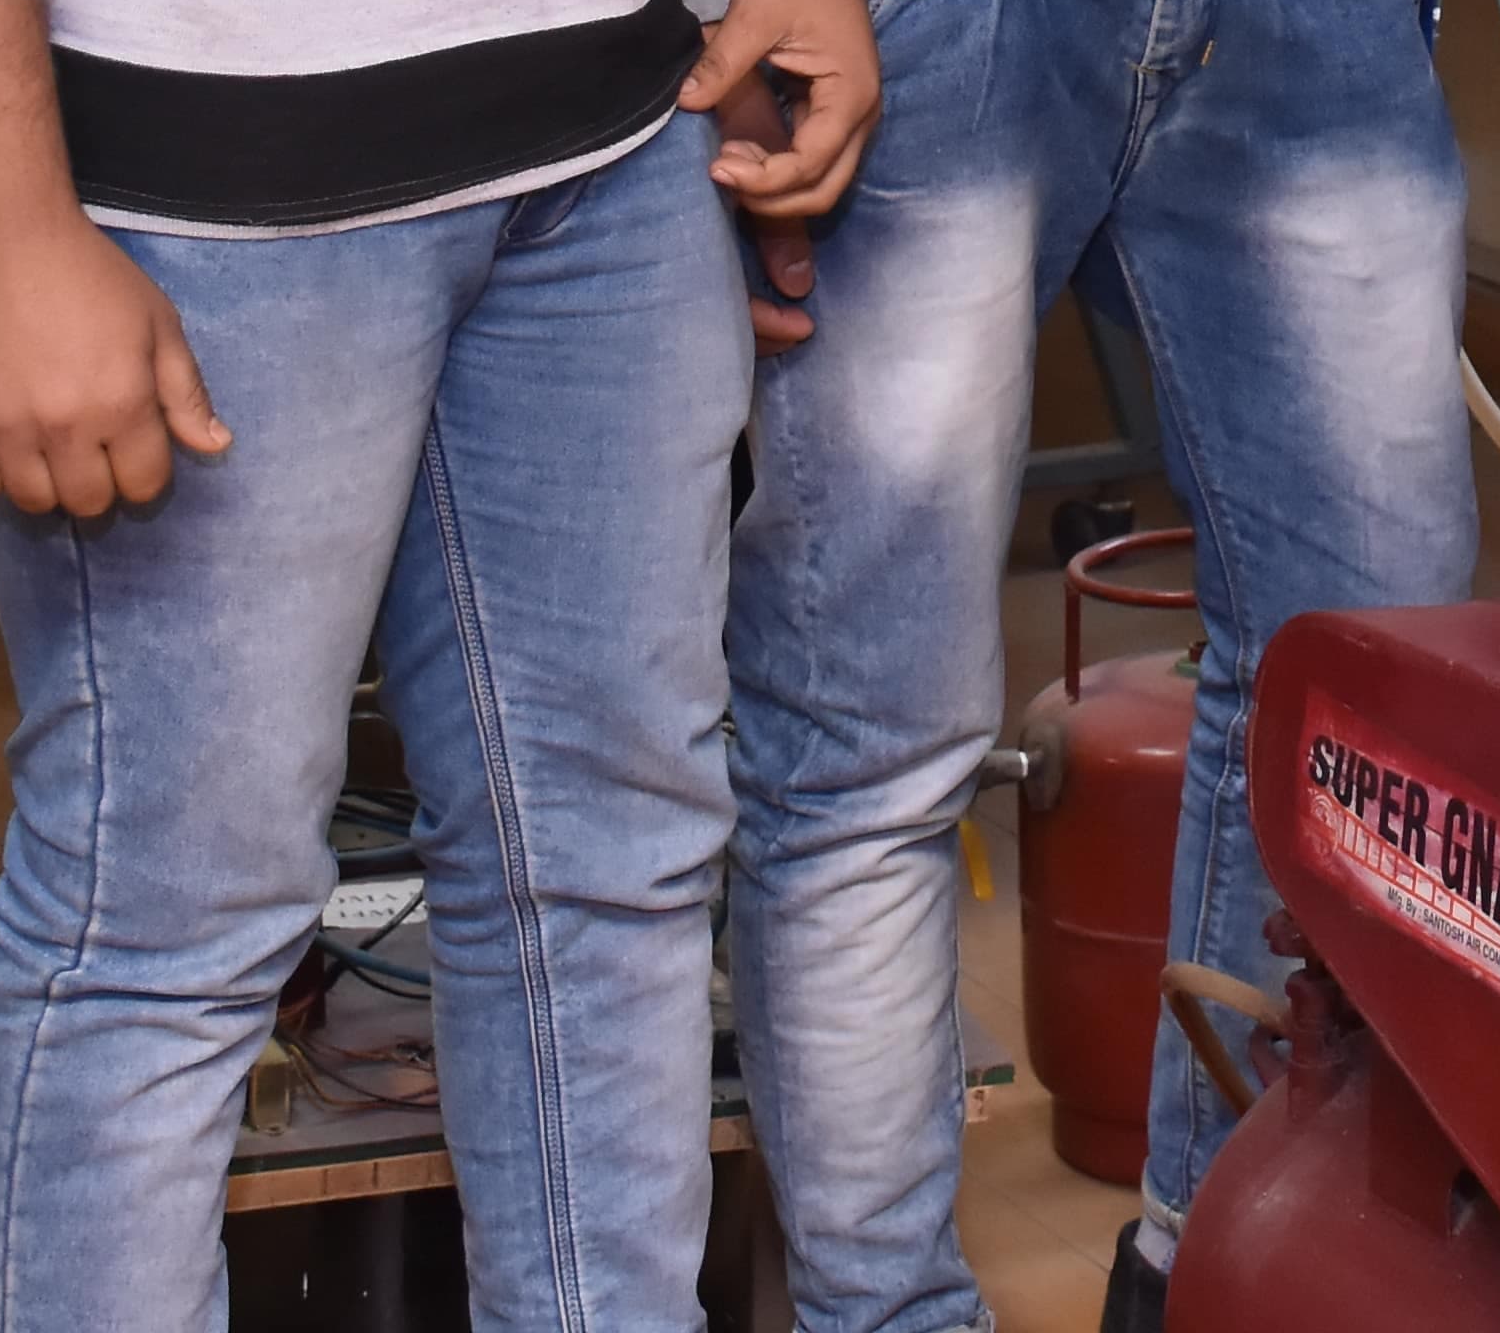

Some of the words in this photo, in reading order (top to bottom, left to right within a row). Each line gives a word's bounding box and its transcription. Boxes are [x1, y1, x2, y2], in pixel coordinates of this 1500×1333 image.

[1310, 735, 1429, 868] SUPER
[1423, 908, 1465, 943] SANTOSH
[1465, 932, 1481, 955] AIR
